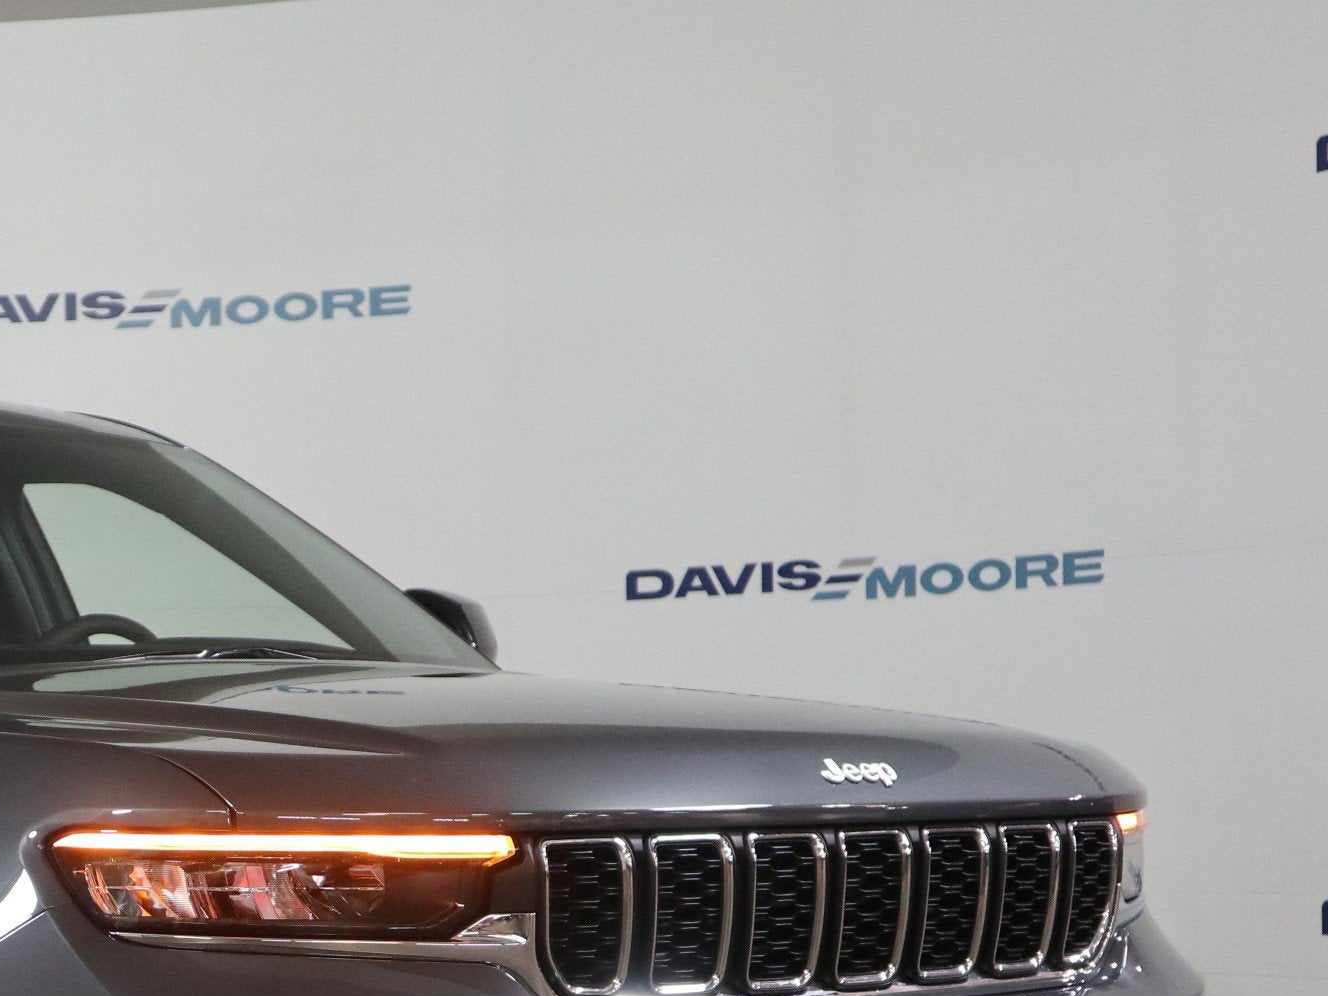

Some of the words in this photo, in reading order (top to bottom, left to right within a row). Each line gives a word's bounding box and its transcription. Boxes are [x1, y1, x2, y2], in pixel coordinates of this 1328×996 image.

[171, 284, 412, 328] MOORE
[625, 559, 822, 600] DAVIS
[866, 549, 1105, 600] MOORE
[821, 758, 897, 787] Jeep
